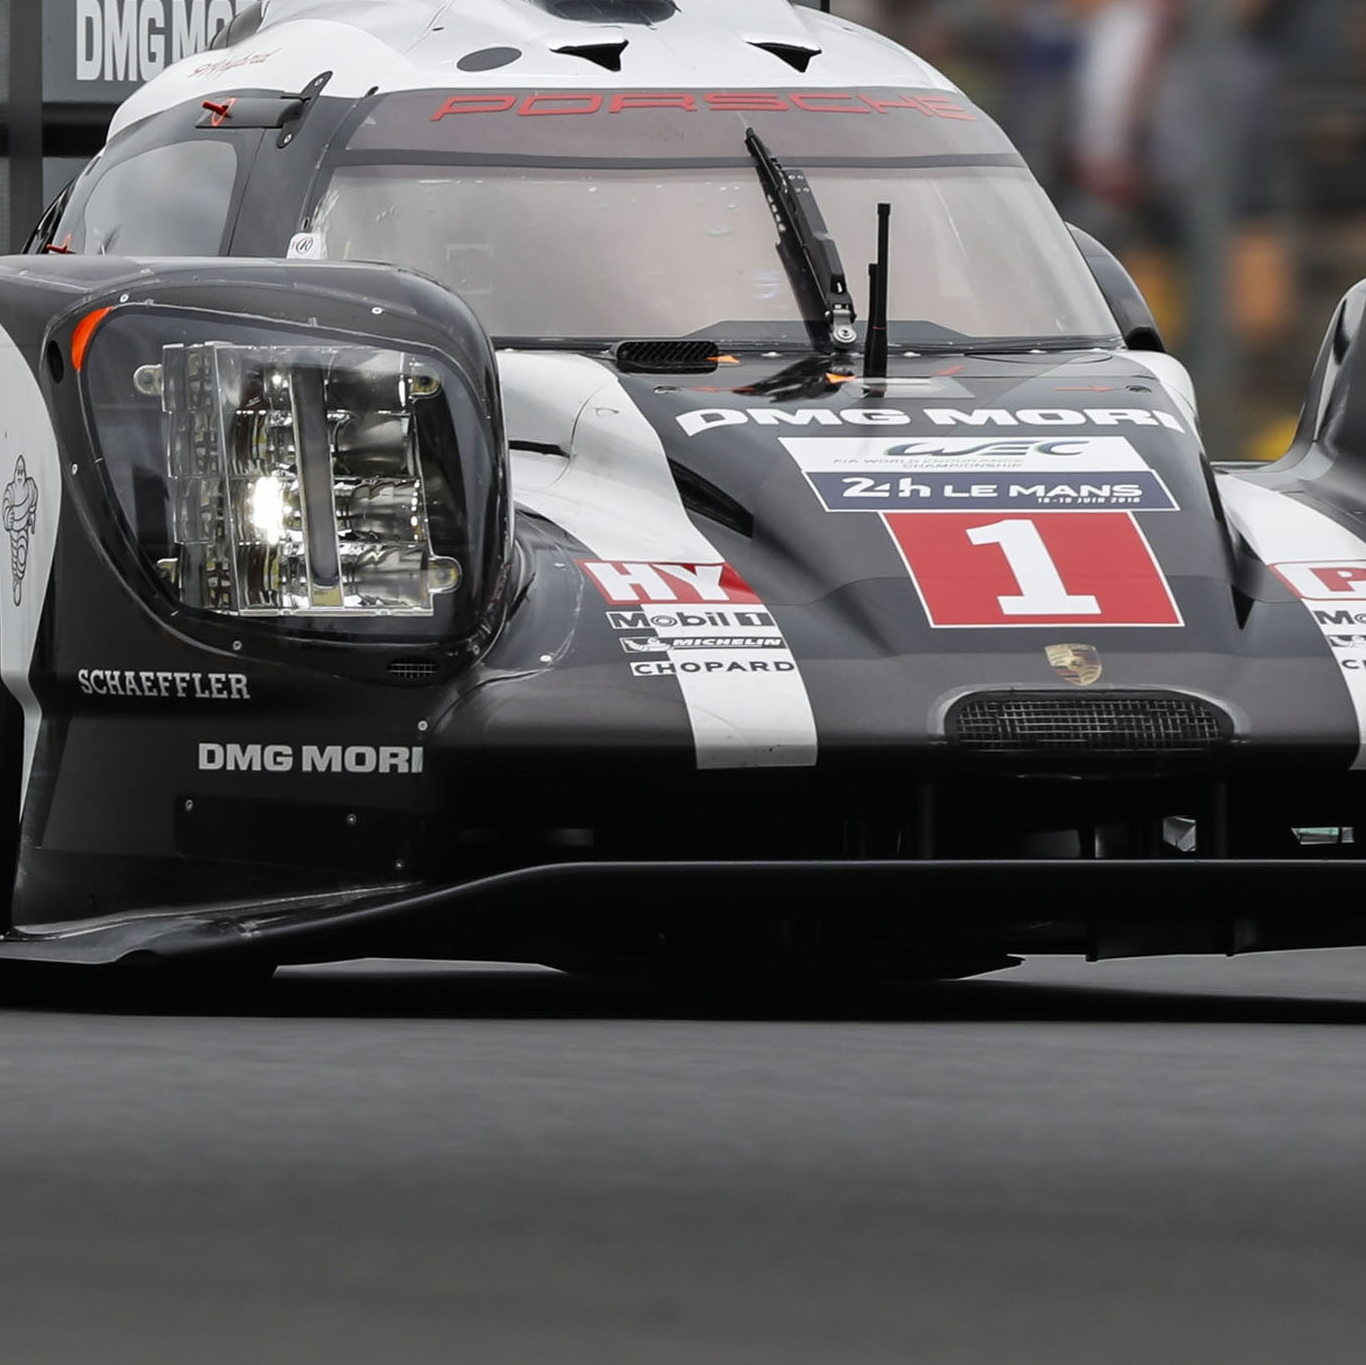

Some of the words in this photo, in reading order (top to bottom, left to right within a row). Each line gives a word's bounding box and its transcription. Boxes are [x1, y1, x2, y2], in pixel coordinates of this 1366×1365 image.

[431, 93, 978, 122] PORSCHE
[676, 408, 912, 436] DMG
[923, 408, 1185, 434] MORI
[884, 440, 1091, 456] WEC
[944, 485, 999, 497] LE
[1008, 484, 1143, 497] MANS
[965, 519, 1102, 615] 1
[585, 562, 730, 601] HY
[609, 612, 731, 628] Mobil
[672, 638, 782, 647] MICHELIN
[634, 661, 795, 675] CHOPARD
[77, 669, 251, 699] SCHAEFFLER
[198, 743, 293, 772] DMG
[301, 745, 424, 773] MORI
